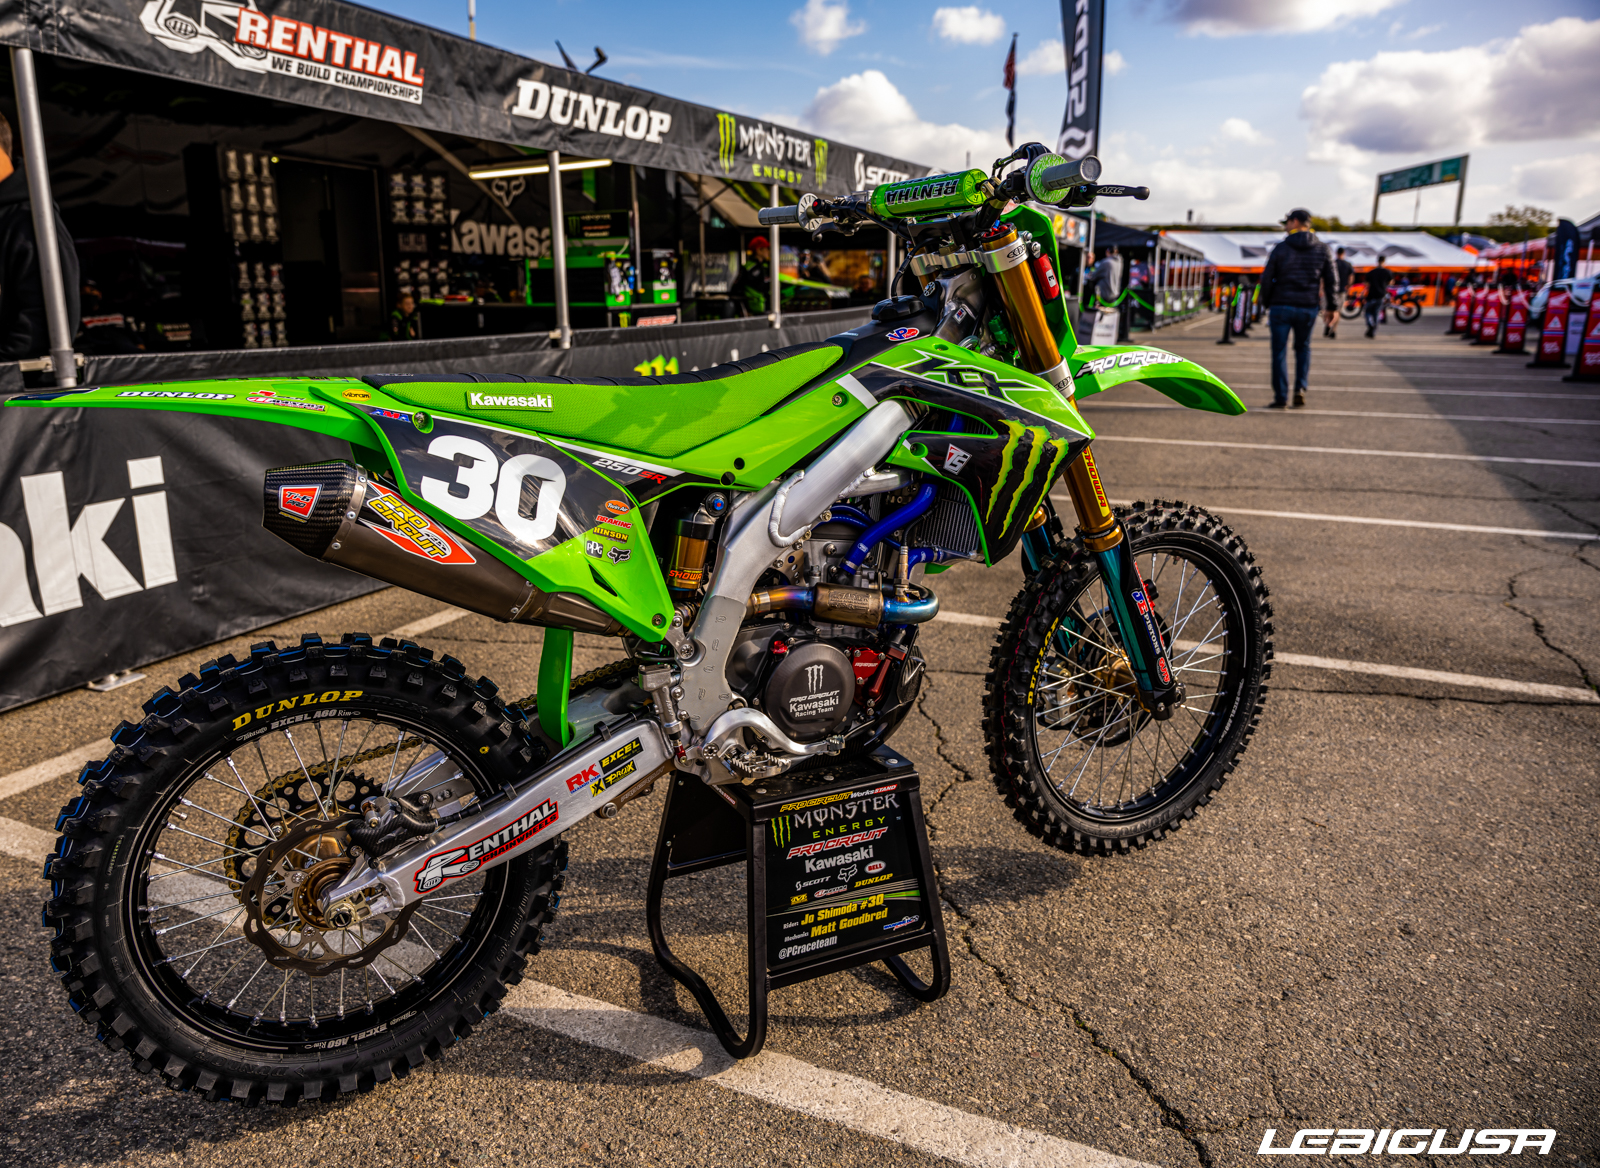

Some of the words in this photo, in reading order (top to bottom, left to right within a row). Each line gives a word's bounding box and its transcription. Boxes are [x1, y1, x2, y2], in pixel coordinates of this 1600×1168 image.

[235, 7, 424, 87] RENTHAL
[271, 56, 292, 73] WE
[296, 62, 331, 81] BUILD
[334, 71, 420, 101] CHAMPIONSHIPS
[512, 78, 672, 144] DUNLOP
[739, 122, 812, 167] MONSTER
[752, 163, 803, 184] ENERGY
[884, 178, 961, 206] RENTHA
[1097, 186, 1126, 194] ARC
[885, 327, 908, 340] VP
[1073, 355, 1118, 379] PRO
[1118, 351, 1183, 368] CIRCUIT
[115, 391, 236, 401] DUNLOP
[470, 392, 553, 408] Kawasaki
[370, 408, 412, 423] AMA
[420, 435, 567, 541] 30
[1083, 447, 1107, 508] SHOWA
[381, 495, 429, 530] PRO
[596, 515, 633, 529] BRAKING
[368, 499, 447, 557] CIRCUIT
[593, 527, 629, 541] HINSON
[1144, 614, 1161, 655] PISTONS
[232, 690, 364, 731] DUNLOP
[789, 696, 808, 704] PRO
[807, 690, 840, 700] CIRCUIT
[790, 696, 839, 713] Kawasaki
[270, 713, 312, 730] EXCEL
[313, 709, 337, 719] A60
[601, 740, 640, 768] EXCEL
[565, 763, 600, 792] RK
[794, 793, 900, 829] MONSTER
[482, 814, 557, 861] CHAINWHEELS
[812, 816, 886, 839] ENERGY
[786, 841, 825, 860] PRO
[823, 826, 889, 851] CIRCUIT
[805, 845, 874, 874] Kawasaki
[867, 863, 883, 872] BELL
[802, 875, 831, 888] SCOTT
[854, 873, 893, 888] DUNLOP
[783, 921, 799, 929] Rider:
[801, 914, 815, 926] Jo
[817, 903, 858, 921] Shimoda
[860, 893, 885, 910] #30
[810, 921, 837, 938] Matt
[839, 907, 889, 930] Goodbred
[779, 936, 838, 960] @PCraceteam
[351, 1023, 388, 1042] EXCEL
